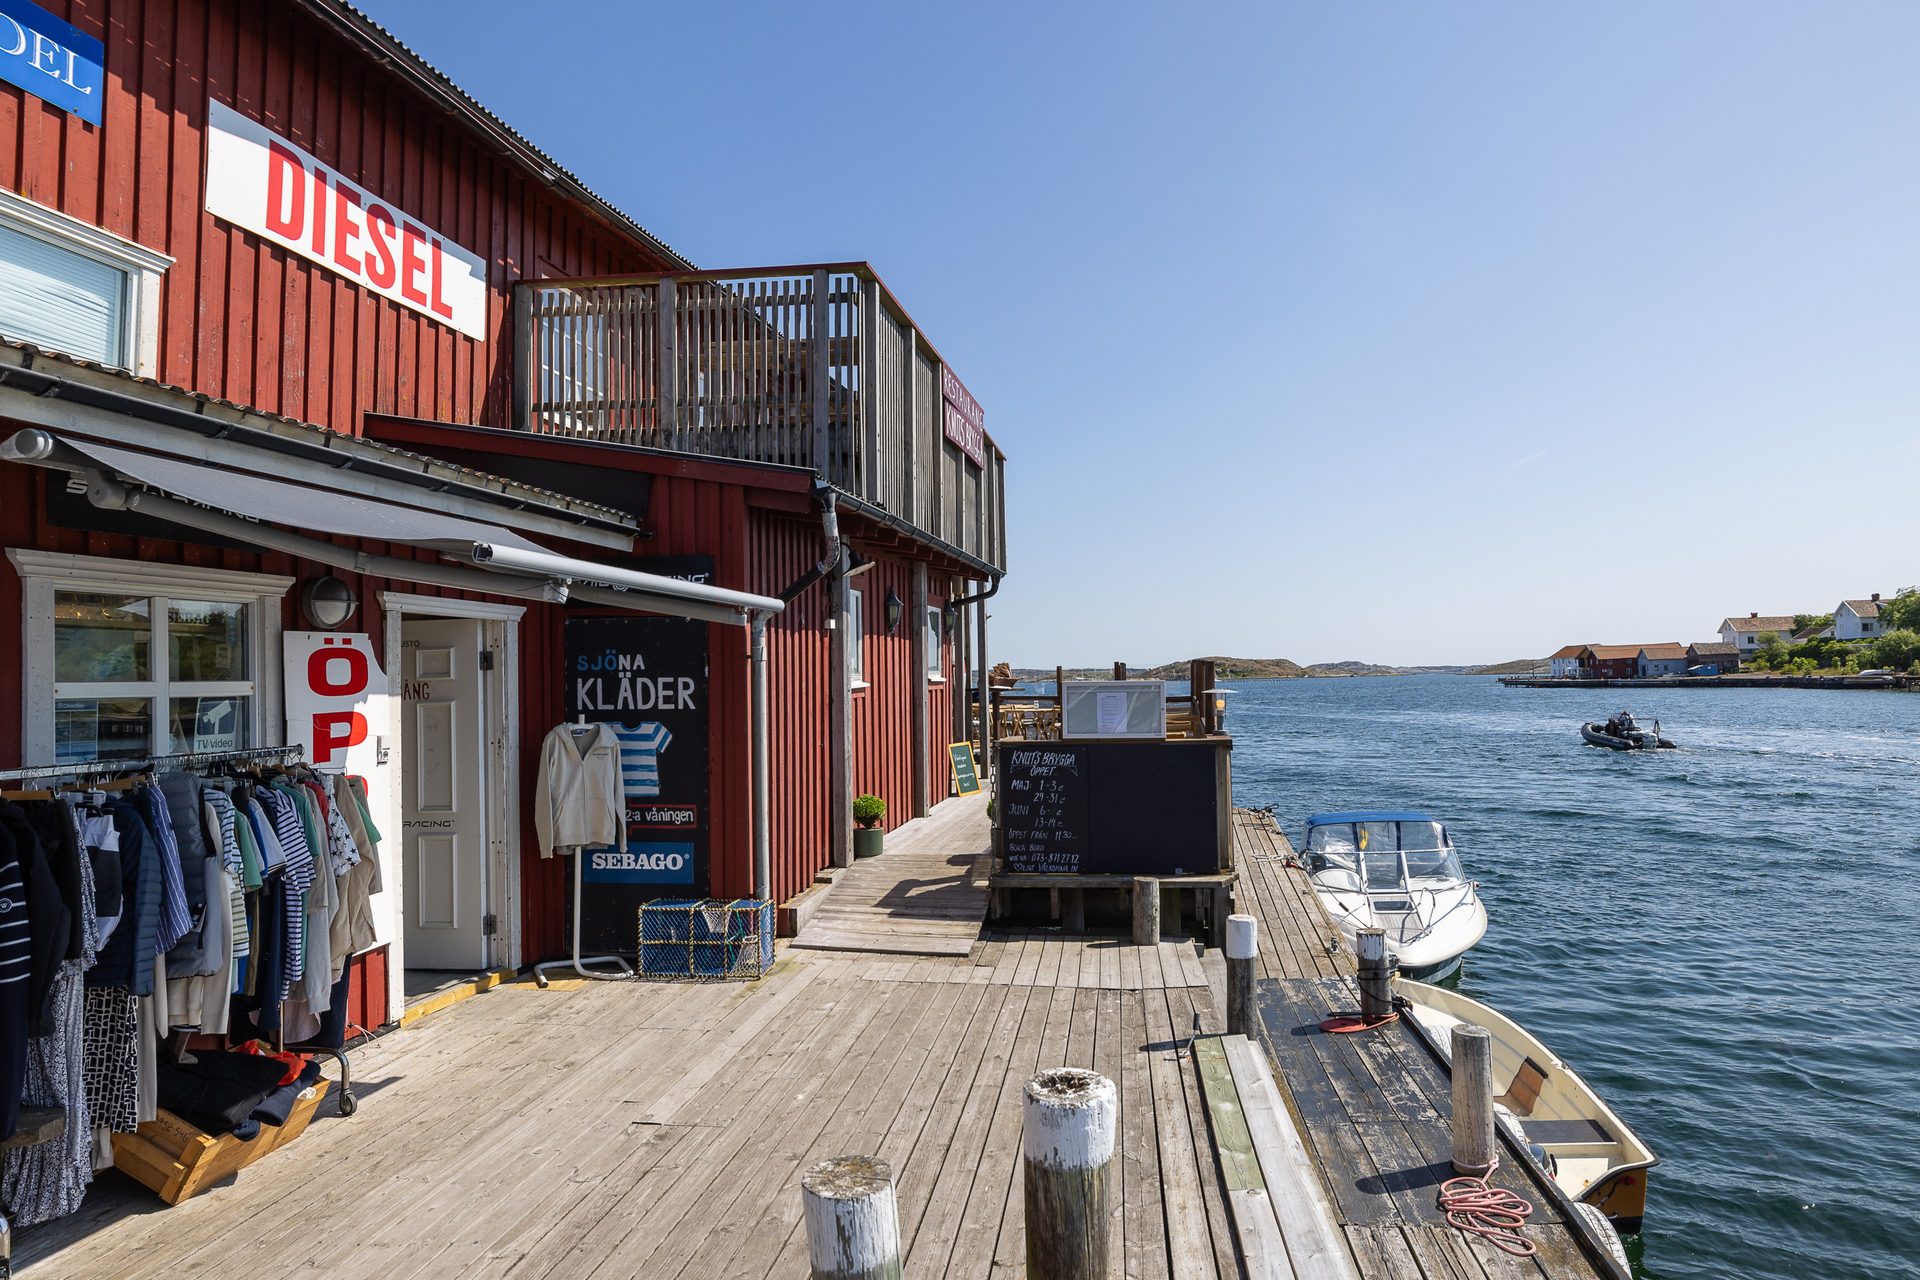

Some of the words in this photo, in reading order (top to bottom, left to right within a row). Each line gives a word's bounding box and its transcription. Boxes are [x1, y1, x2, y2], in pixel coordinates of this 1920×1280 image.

[266, 138, 453, 321] DIESEL
[577, 649, 646, 671] SJÖNA
[401, 678, 430, 701] ÅNG
[577, 671, 696, 710] KLÄDER
[1011, 750, 1041, 765] KNUTS
[1041, 752, 1075, 766] BRYGGA
[1030, 765, 1057, 776] ÖPPET
[645, 806, 694, 825] våningen
[1008, 803, 1030, 816] JUNI
